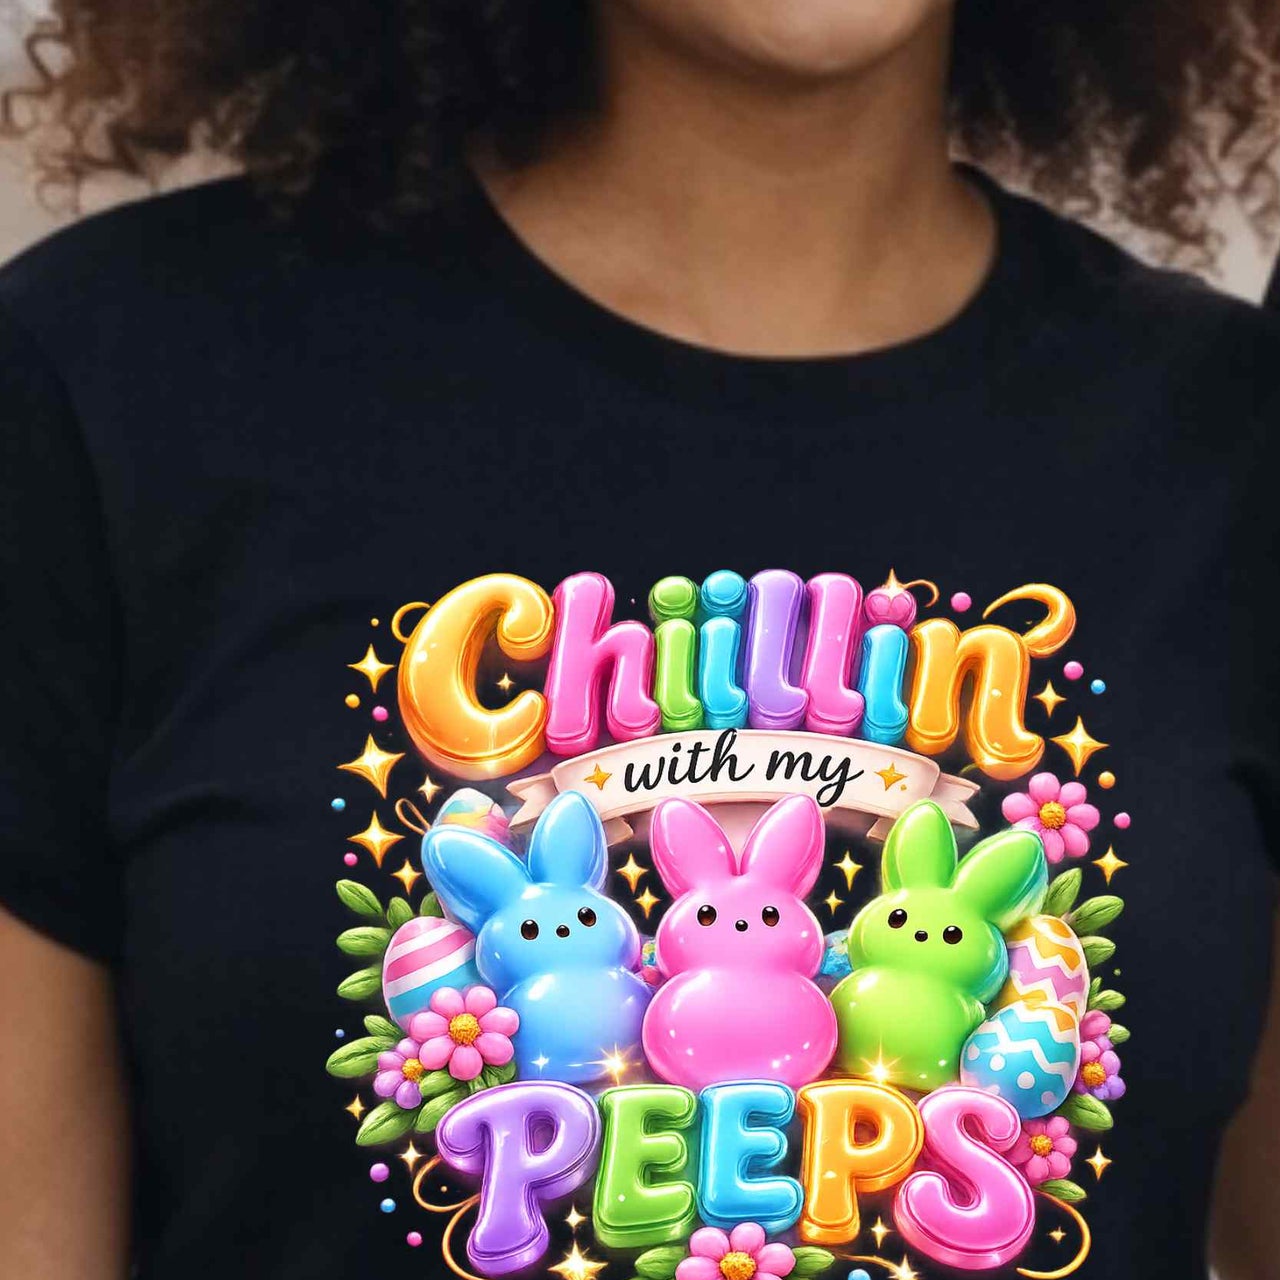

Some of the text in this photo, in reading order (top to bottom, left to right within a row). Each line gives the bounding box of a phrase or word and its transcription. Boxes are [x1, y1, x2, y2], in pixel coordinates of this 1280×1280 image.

[624, 727, 865, 807] with my
[436, 1078, 1036, 1274] PEEPS
